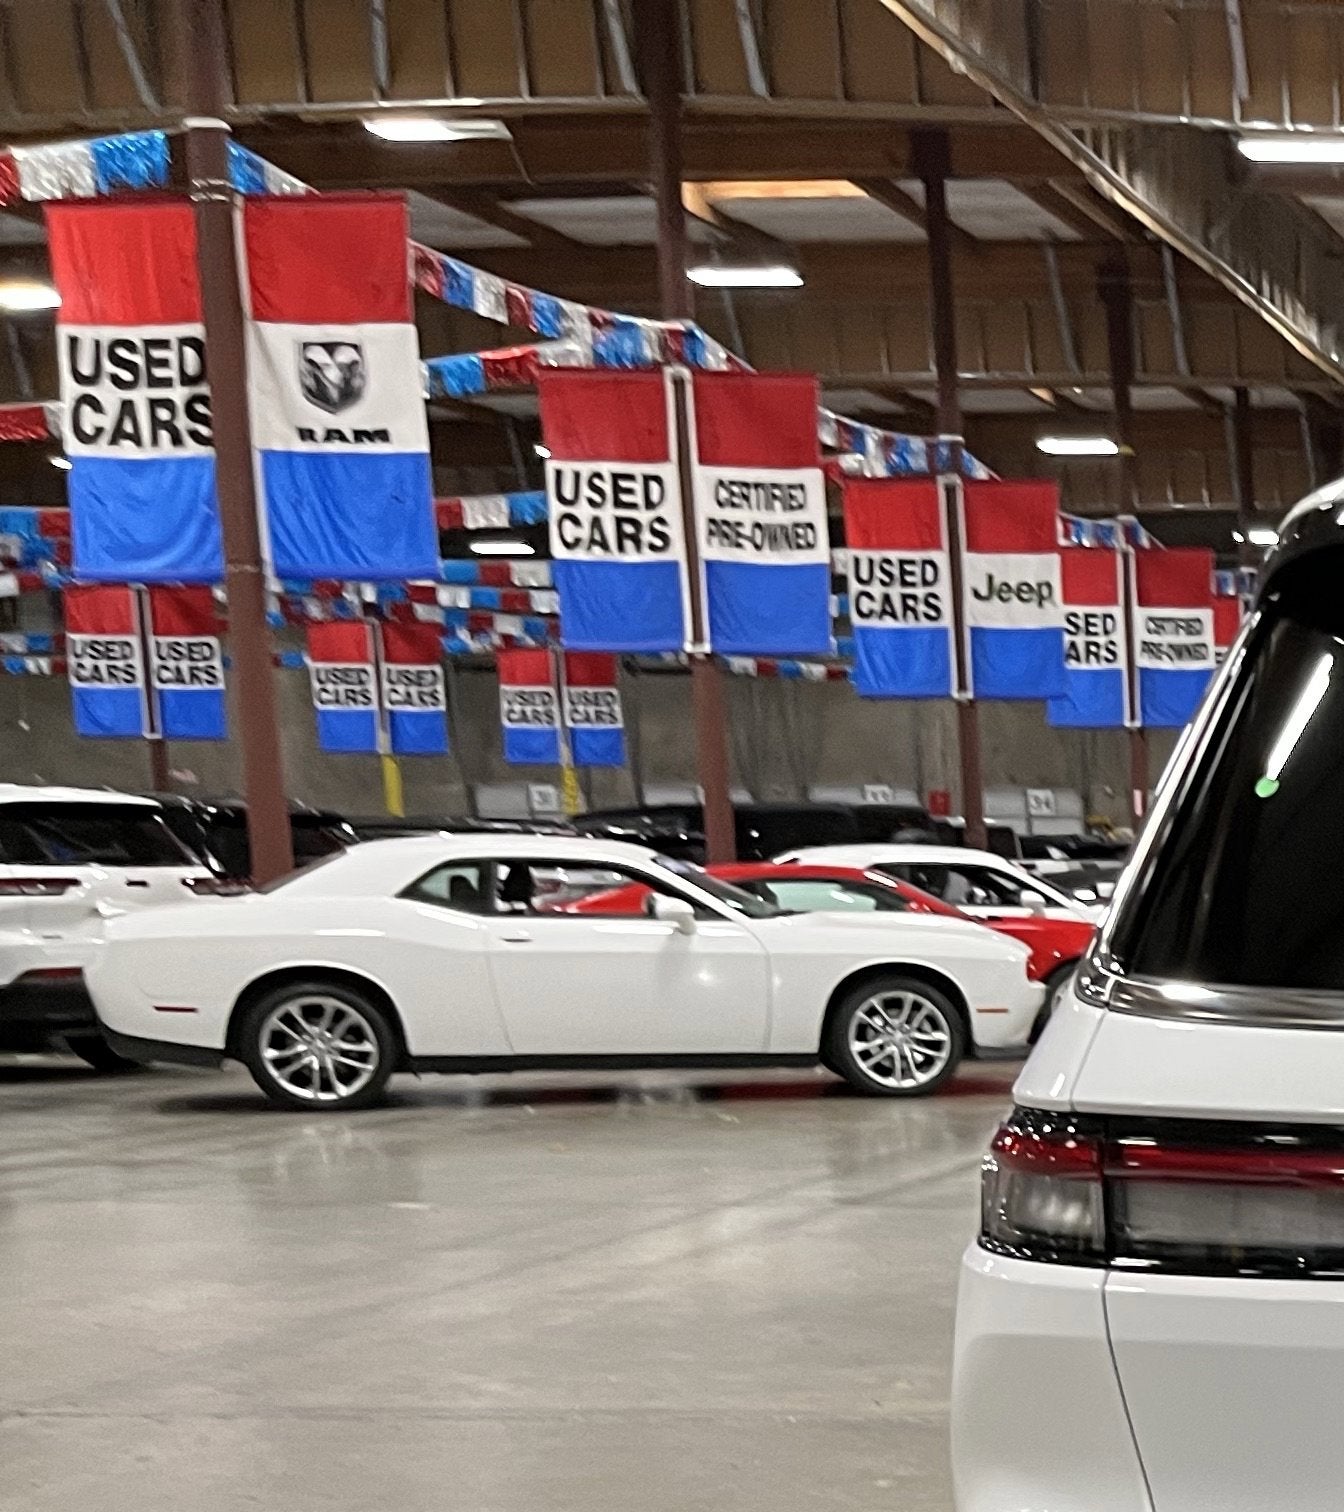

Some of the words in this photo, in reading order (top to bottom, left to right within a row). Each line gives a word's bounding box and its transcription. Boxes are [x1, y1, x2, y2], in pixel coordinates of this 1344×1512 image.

[68, 335, 206, 389] USED
[71, 393, 213, 448] CARS
[297, 427, 391, 444] RAM
[554, 468, 665, 510] USED
[715, 479, 806, 513] CERTIFIED
[557, 512, 671, 553] CARS
[706, 517, 817, 552] PRE-OWNED
[853, 555, 939, 588] USED
[972, 573, 1055, 609] Jeep
[855, 590, 943, 622] CARS
[1064, 612, 1117, 636] SED
[73, 639, 135, 660] USED
[156, 641, 215, 661] USED
[1064, 640, 1118, 664] ARS
[74, 662, 137, 684] CARS
[157, 664, 218, 685] CARS
[315, 667, 370, 685] USED
[387, 668, 438, 687] USED
[317, 687, 372, 706] CARS
[388, 688, 441, 707] CARS
